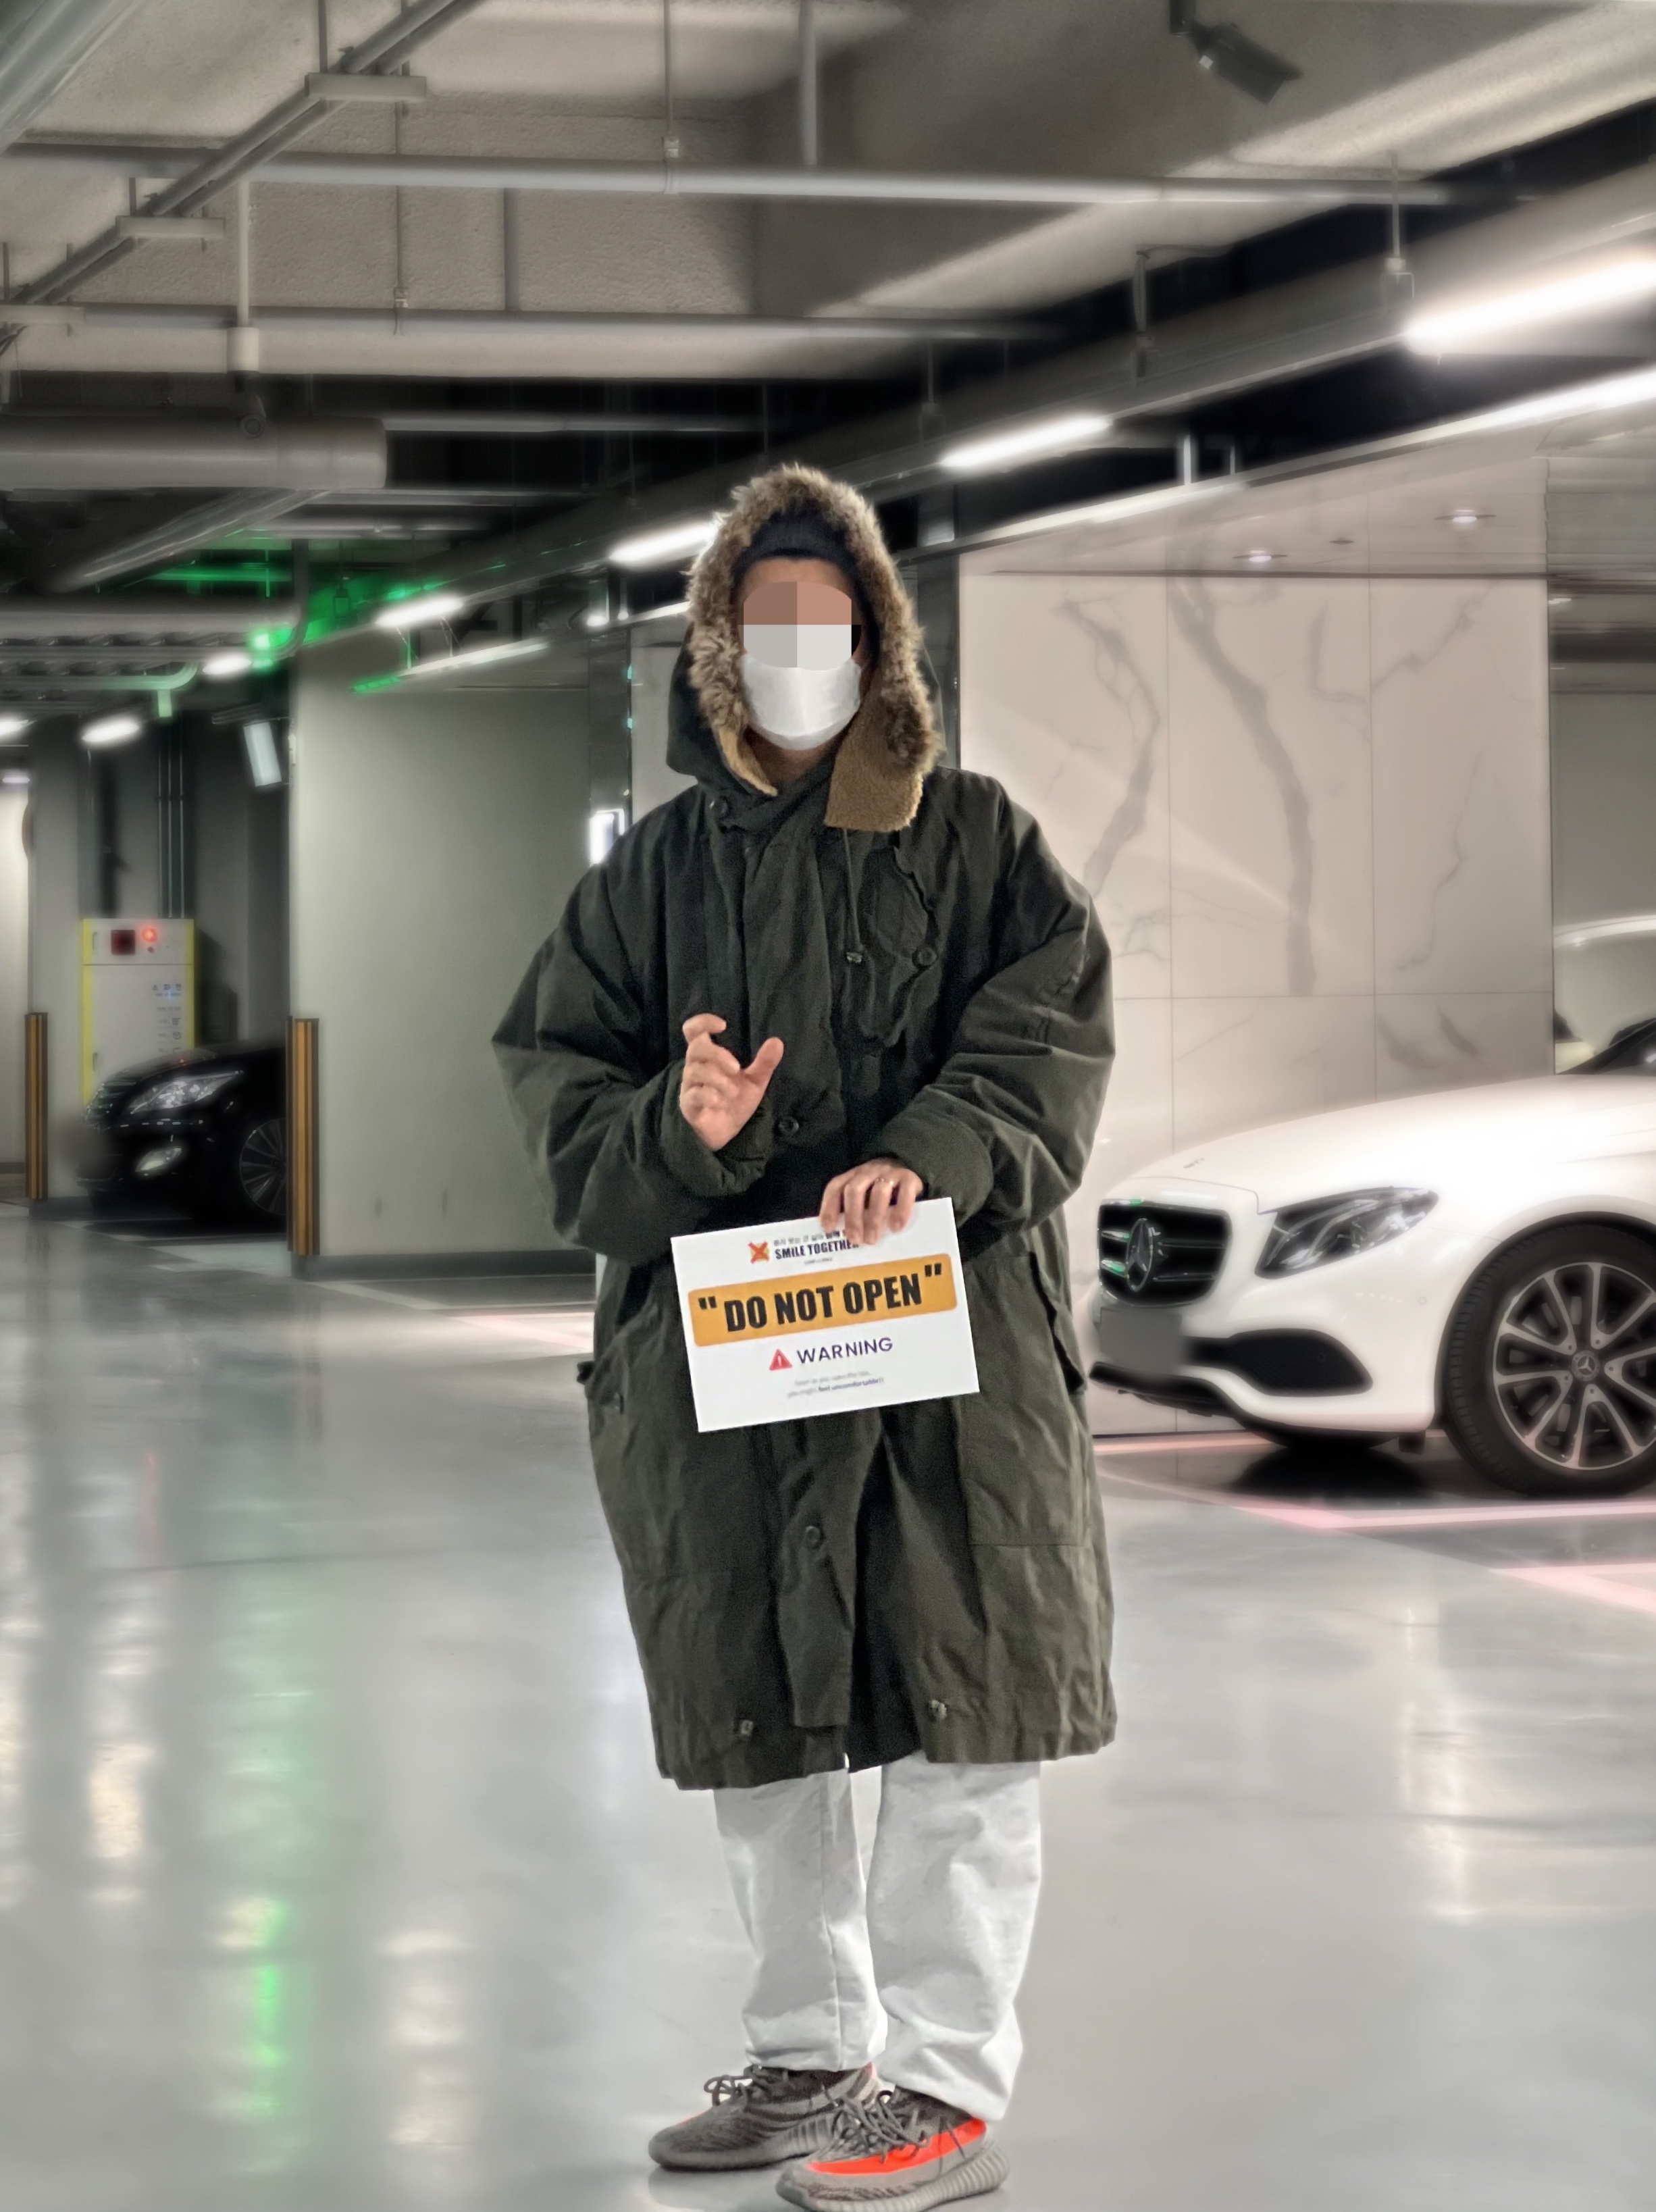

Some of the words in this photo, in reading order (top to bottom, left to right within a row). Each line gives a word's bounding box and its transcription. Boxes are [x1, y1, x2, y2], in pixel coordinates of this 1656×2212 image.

[775, 1245, 805, 1260] SMILE
[775, 1285, 834, 1324] NOT
[797, 1337, 893, 1364] WARNING
